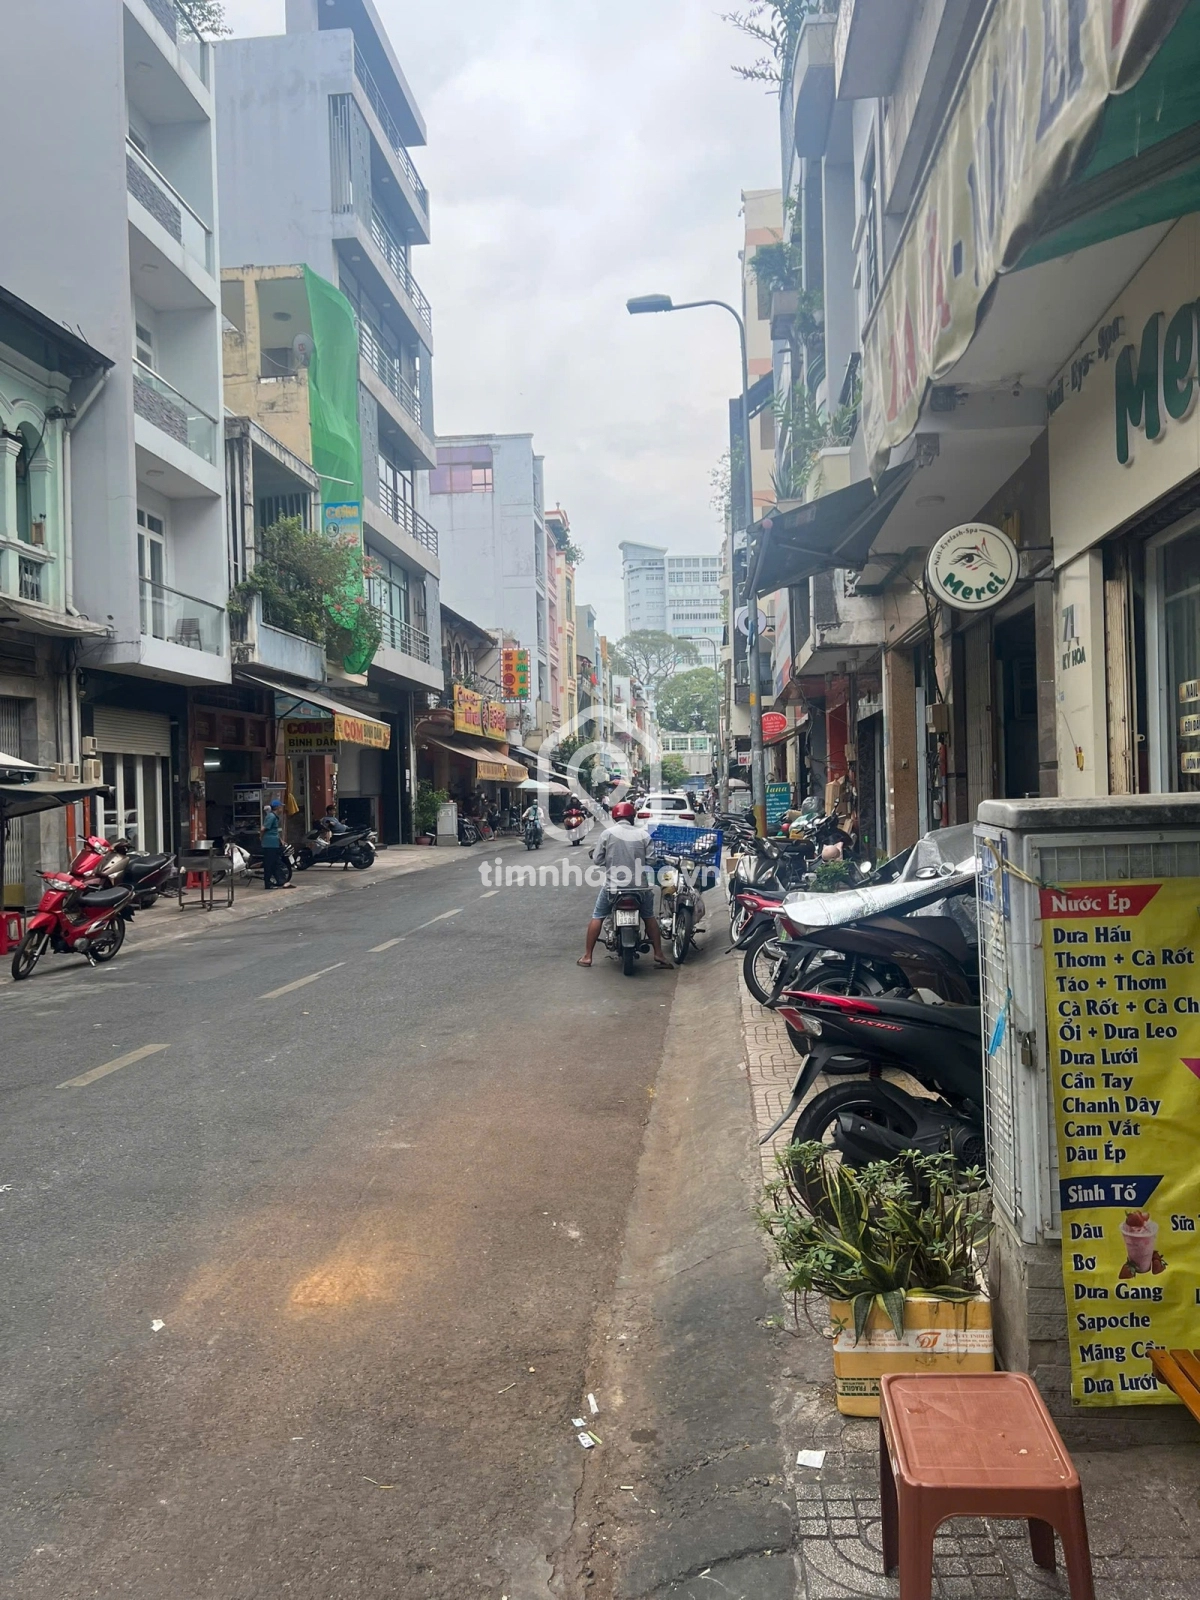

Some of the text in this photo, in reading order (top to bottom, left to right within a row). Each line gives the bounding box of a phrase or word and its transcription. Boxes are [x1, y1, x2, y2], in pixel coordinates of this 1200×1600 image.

[1115, 299, 1200, 466] Me
[942, 571, 1006, 601] Merci
[1061, 604, 1076, 642] 71
[1185, 682, 1199, 698] NAIL
[288, 736, 337, 747] BÌNH DÂN
[766, 785, 788, 793] lana
[1051, 890, 1131, 913] Nước Ép
[1053, 925, 1132, 944] Dưa Hấu
[1054, 947, 1195, 969] Thơm + Cà Rốt
[1056, 975, 1167, 993] Táo + Thơm
[1058, 1000, 1081, 1017] Cà
[1086, 998, 1119, 1016] Rốt
[1126, 1001, 1137, 1012] +
[1144, 998, 1167, 1014] Cà
[1059, 1018, 1178, 1042] Ổi + Dưa Leo
[1060, 1047, 1138, 1065] Dưa Lưới
[1061, 1072, 1134, 1091] Cần Tay
[1062, 1096, 1161, 1116] Chanh Dây
[1064, 1119, 1141, 1137] Cam Vắt
[1066, 1140, 1126, 1163] Dâu Ép
[1068, 1182, 1138, 1203] Sinh Tố
[1070, 1222, 1103, 1240] Dâu
[1171, 1214, 1195, 1231] Sữa
[1073, 1254, 1096, 1271] Bơ
[1074, 1283, 1163, 1302] Dưa Gang
[1077, 1312, 1151, 1332] Sapoche
[1079, 1340, 1166, 1362] Mãng Cầ
[1083, 1373, 1158, 1394] Dưa Lưới
